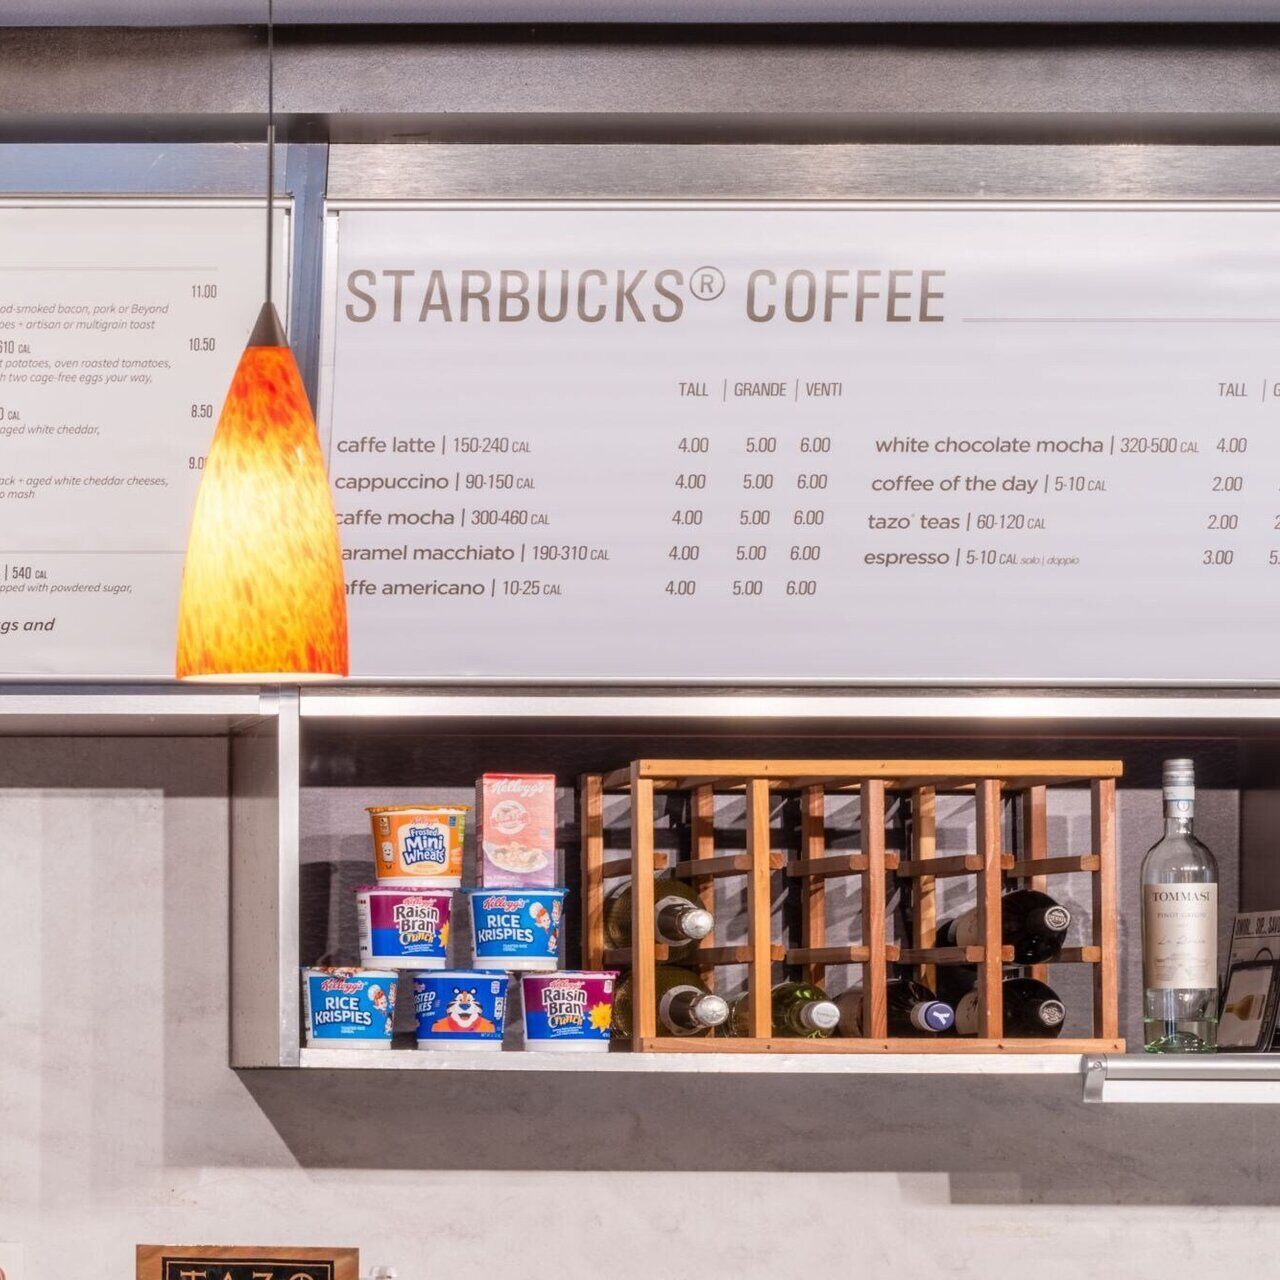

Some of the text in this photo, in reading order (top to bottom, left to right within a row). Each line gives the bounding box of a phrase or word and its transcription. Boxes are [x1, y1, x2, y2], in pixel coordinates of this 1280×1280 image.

[746, 269, 946, 323] COFFEE
[678, 382, 843, 397] TALL GRANDE VENTI
[7, 410, 20, 421] CAL
[190, 404, 214, 421] 8.50
[336, 436, 831, 453] caffe latte 150-240 CAL 4.00 5.00 6.00
[875, 436, 1248, 454] white chocolate mocha 320-500 CAL 4.00
[863, 552, 950, 568] espresso
[966, 549, 997, 565] 5-10
[999, 553, 1018, 565] CAL
[1202, 549, 1234, 566] 3.00
[12, 566, 32, 580] 540
[34, 570, 47, 580] CAL
[409, 827, 438, 837] Frosted
[405, 835, 443, 852] Mini
[403, 848, 446, 866] Wheats
[483, 896, 525, 912] Kellogg's
[1153, 891, 1210, 902] TOMMASI
[395, 905, 438, 921] Raisin
[486, 914, 521, 928] RICE
[401, 919, 435, 932] Bran
[478, 928, 534, 943] KRISPIES
[321, 978, 364, 995] Kellogg's
[325, 996, 359, 1010] RICE
[543, 988, 586, 1004] Raisin
[549, 1002, 582, 1016] Bran
[315, 1010, 372, 1026] KRISPIES
